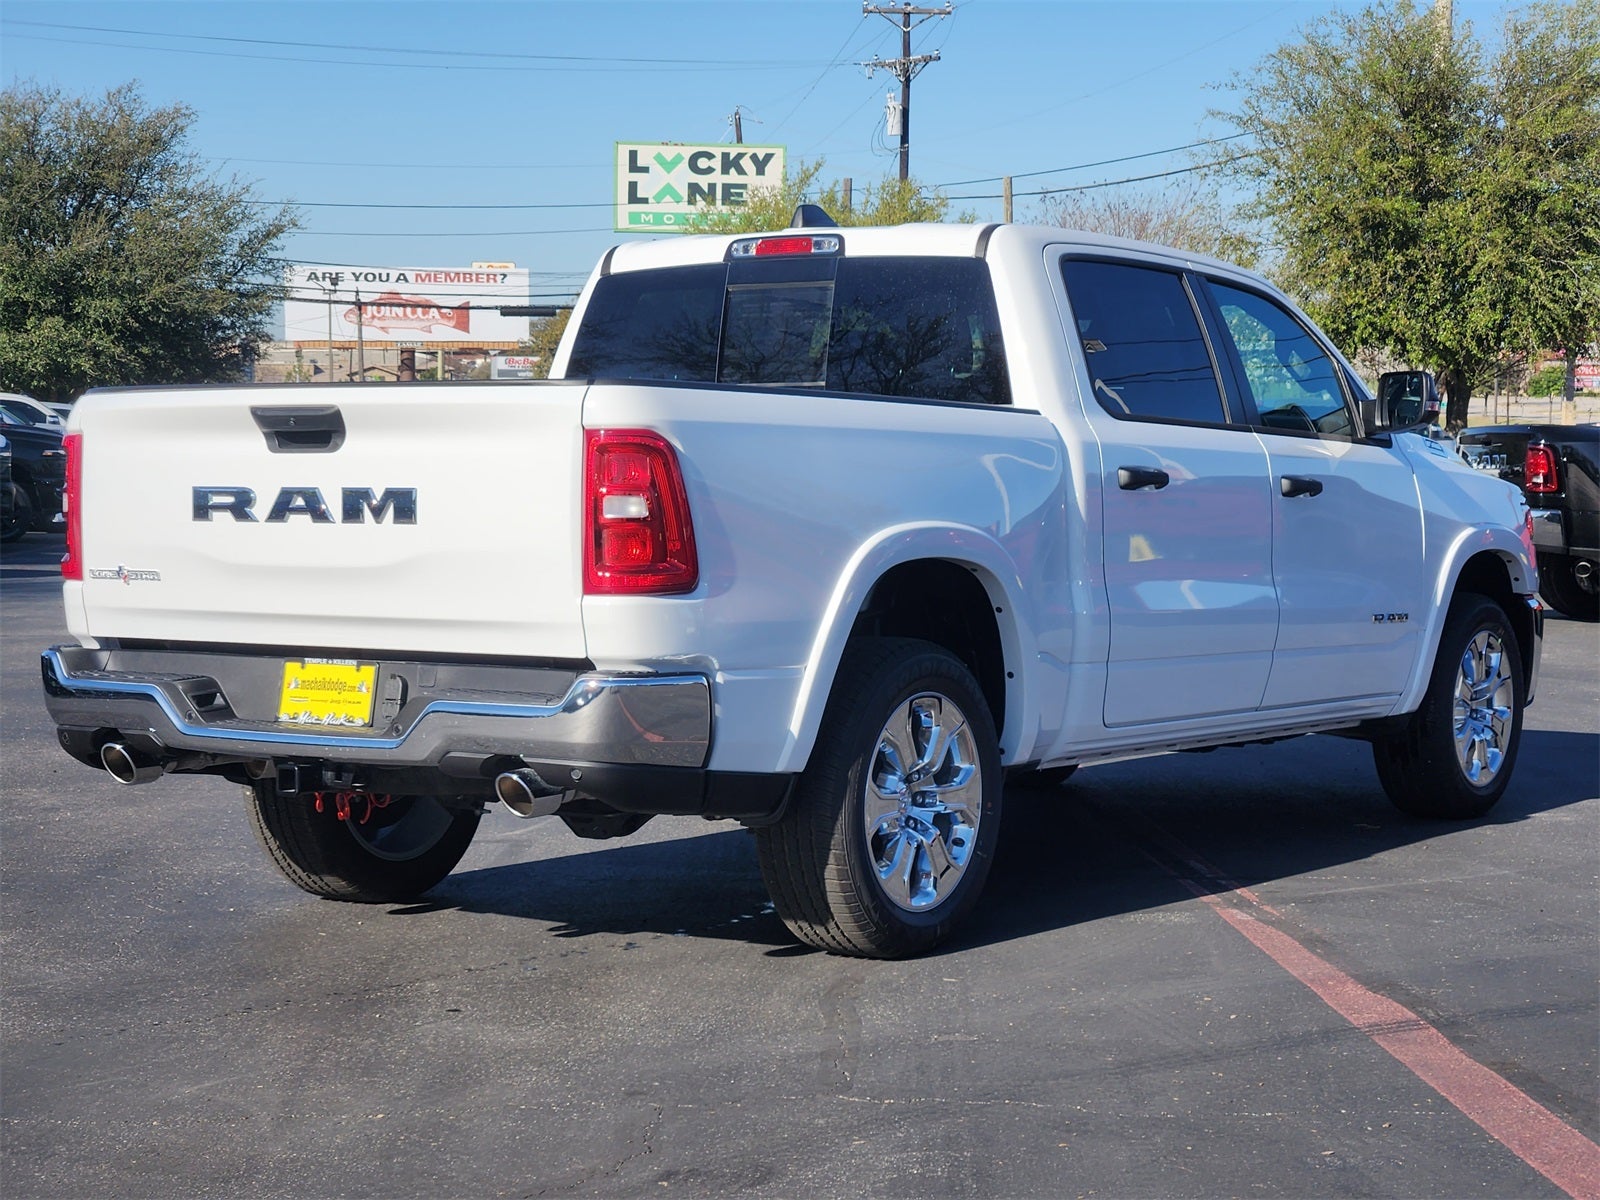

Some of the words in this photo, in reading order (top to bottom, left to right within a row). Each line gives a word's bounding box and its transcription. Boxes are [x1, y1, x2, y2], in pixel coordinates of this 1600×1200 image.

[306, 271, 345, 282] ARE
[350, 272, 390, 283] YOU
[395, 273, 410, 283] A
[192, 486, 418, 525] RAM
[1372, 613, 1409, 624] RAM
